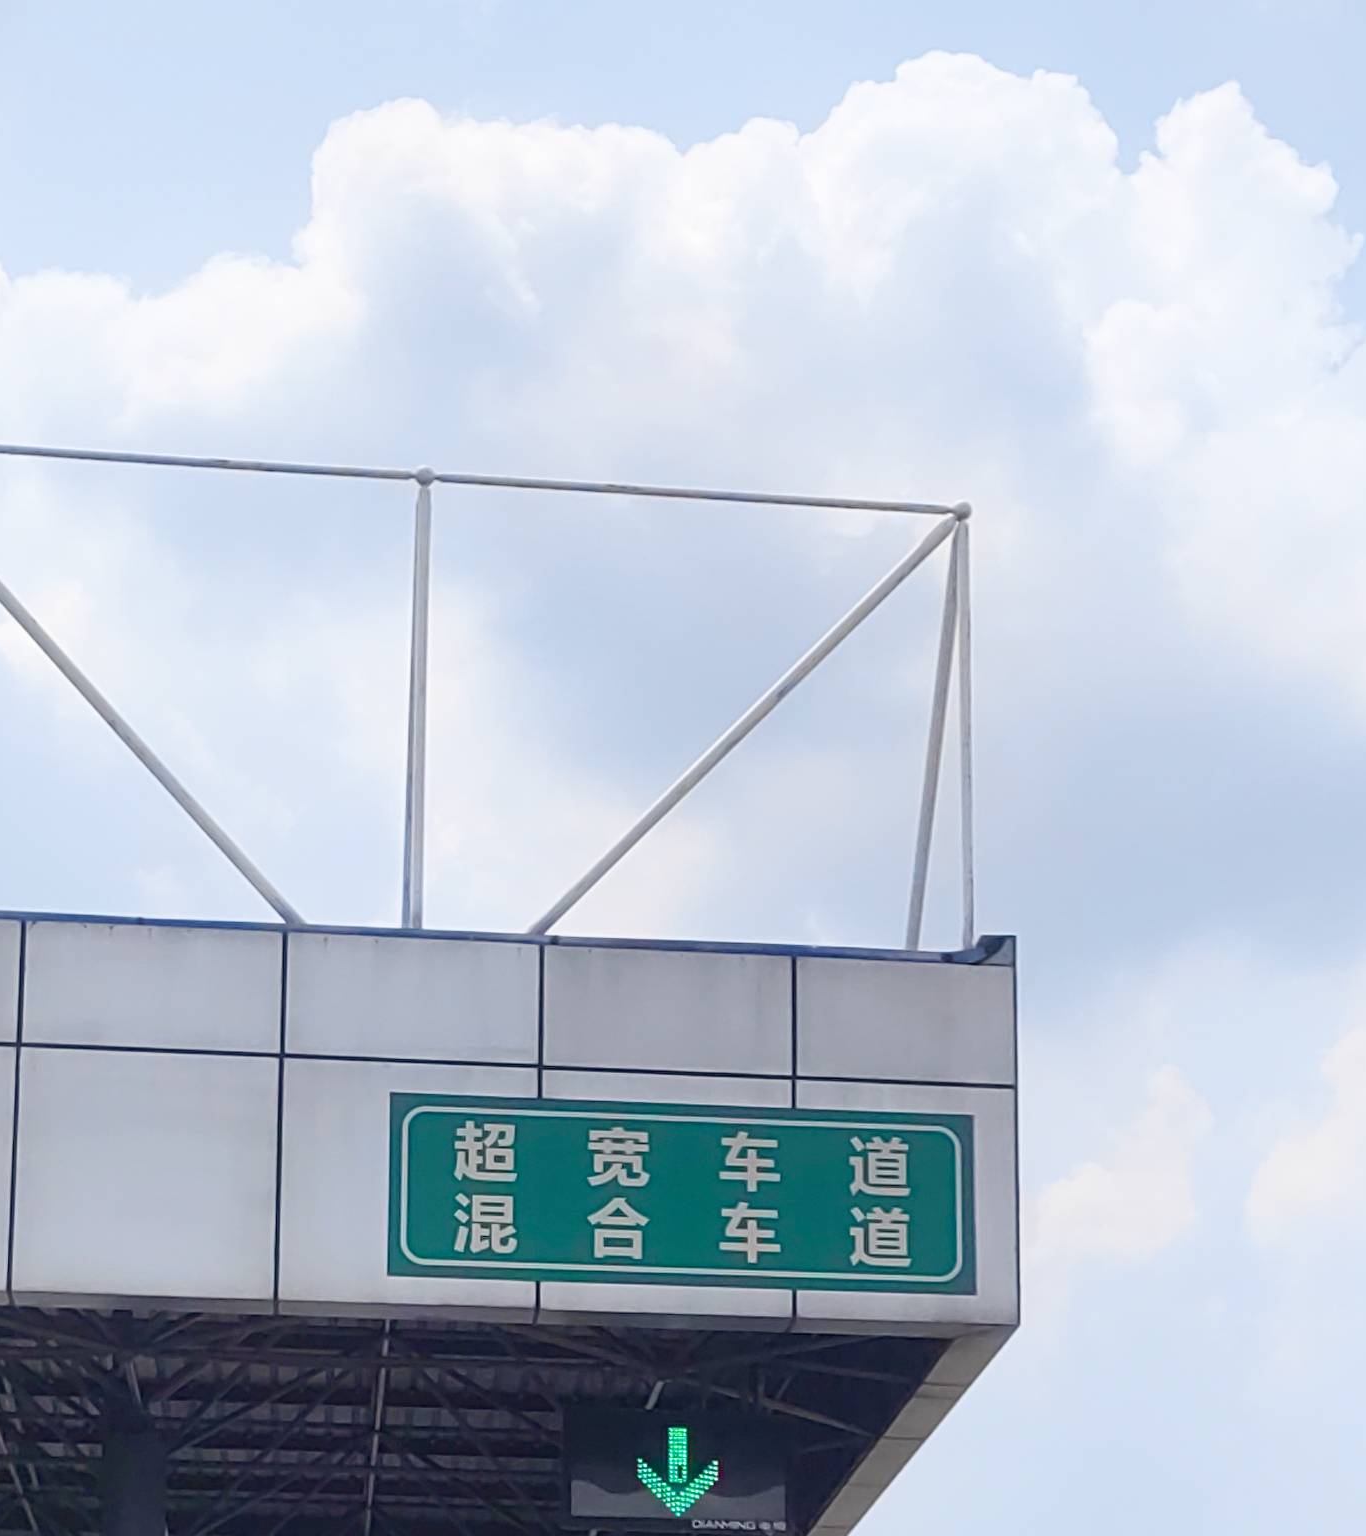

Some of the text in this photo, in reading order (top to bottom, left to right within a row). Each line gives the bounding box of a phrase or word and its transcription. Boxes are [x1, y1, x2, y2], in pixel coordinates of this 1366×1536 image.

[453, 1120, 912, 1198] 超宽车道
[453, 1192, 913, 1268] 混合车道
